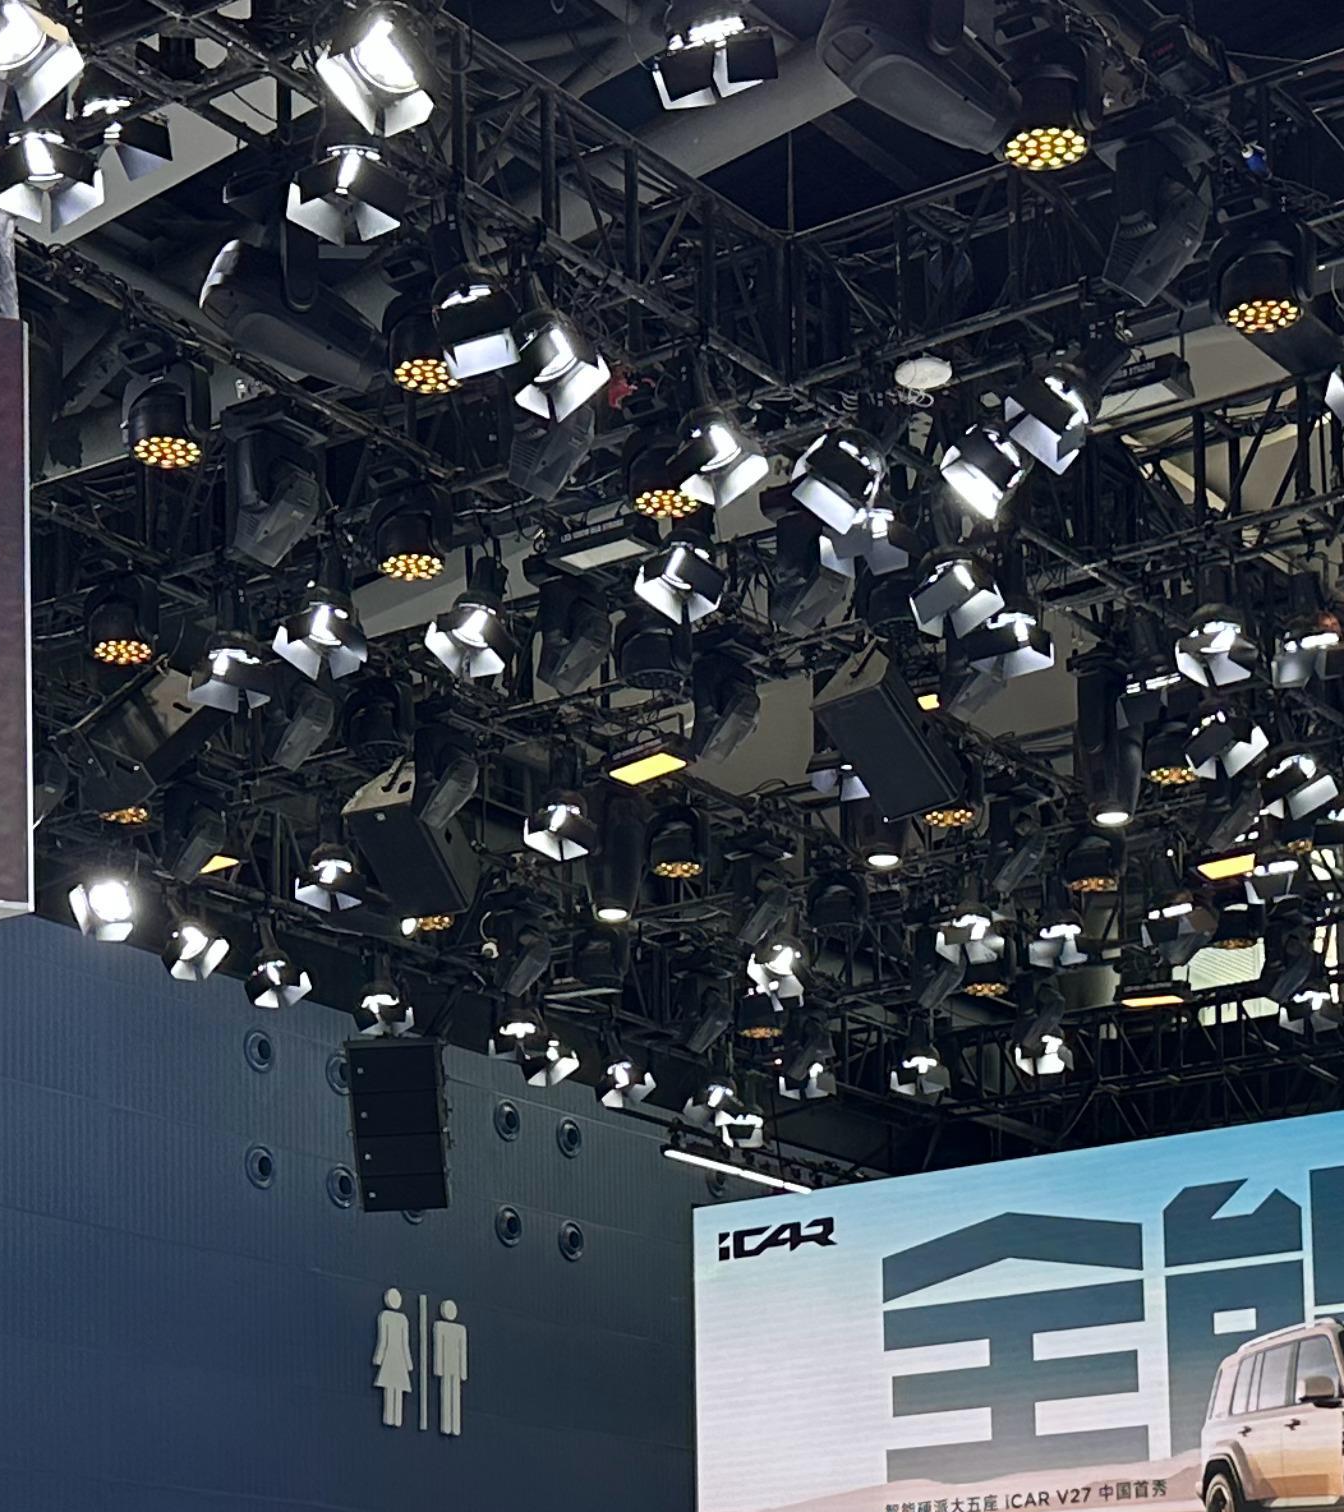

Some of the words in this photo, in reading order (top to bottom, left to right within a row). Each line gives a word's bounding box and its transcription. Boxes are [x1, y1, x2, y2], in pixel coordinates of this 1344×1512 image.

[1005, 1492, 1050, 1510] iCAR
[1056, 1487, 1092, 1504] V27
[1099, 1479, 1168, 1501] 中国首秀
